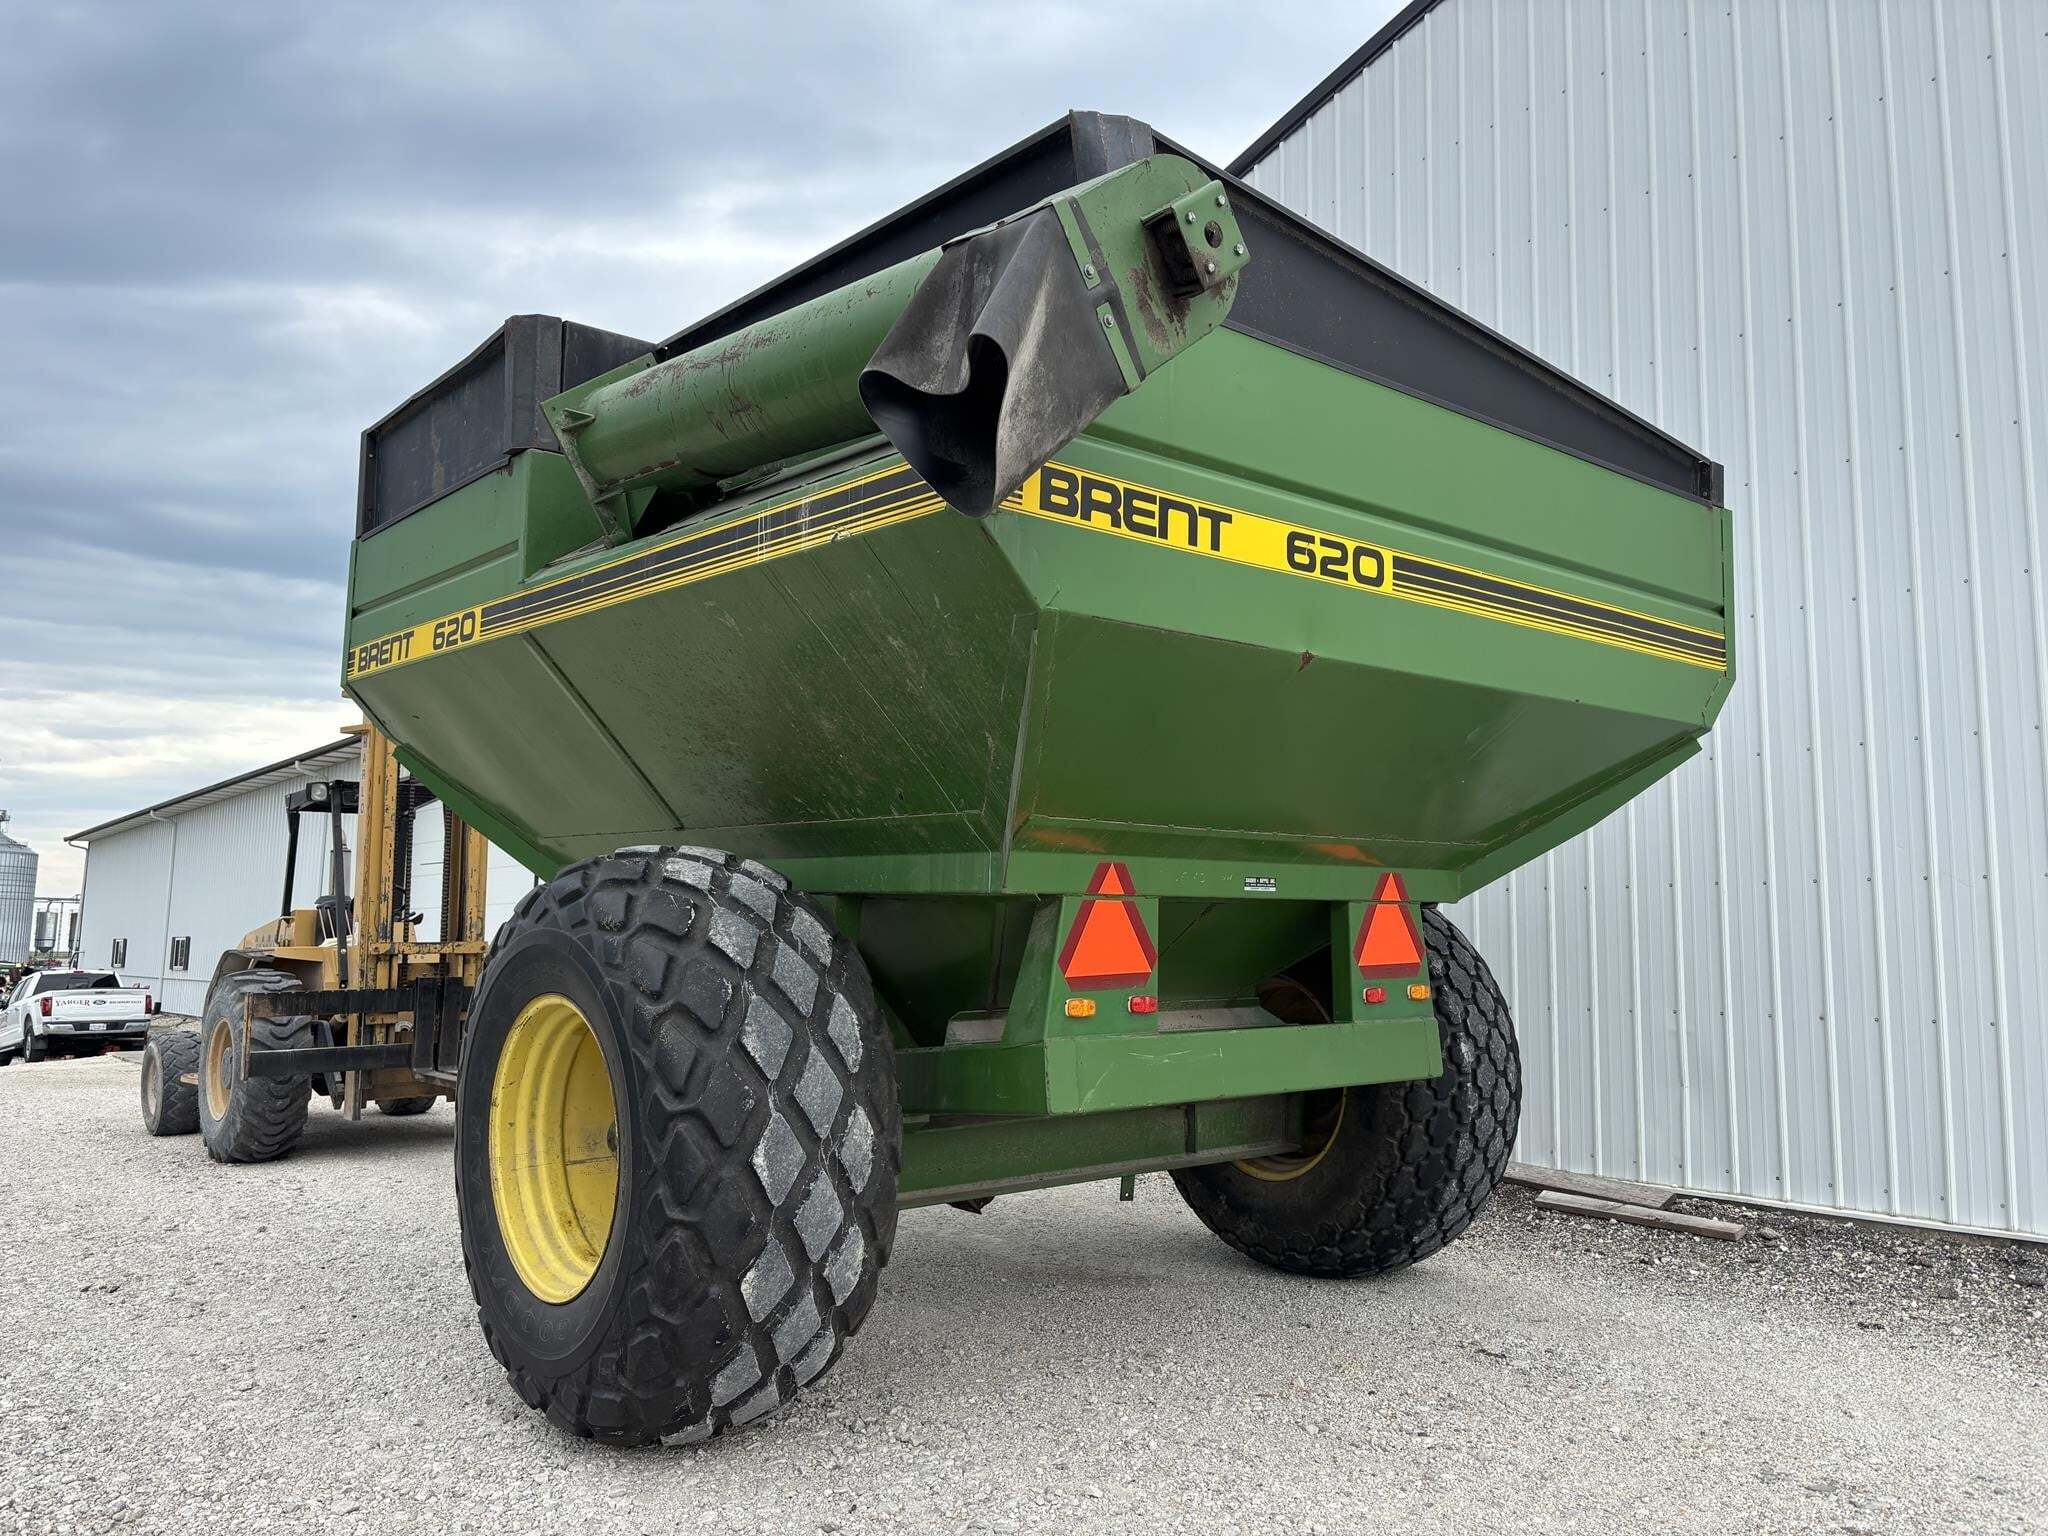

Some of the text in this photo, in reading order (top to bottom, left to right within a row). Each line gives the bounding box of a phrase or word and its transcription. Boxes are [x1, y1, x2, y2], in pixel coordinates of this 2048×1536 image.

[1039, 465, 1385, 589] BRENT 620
[358, 610, 476, 673] BRENT 620
[55, 999, 90, 1007] YARGER
